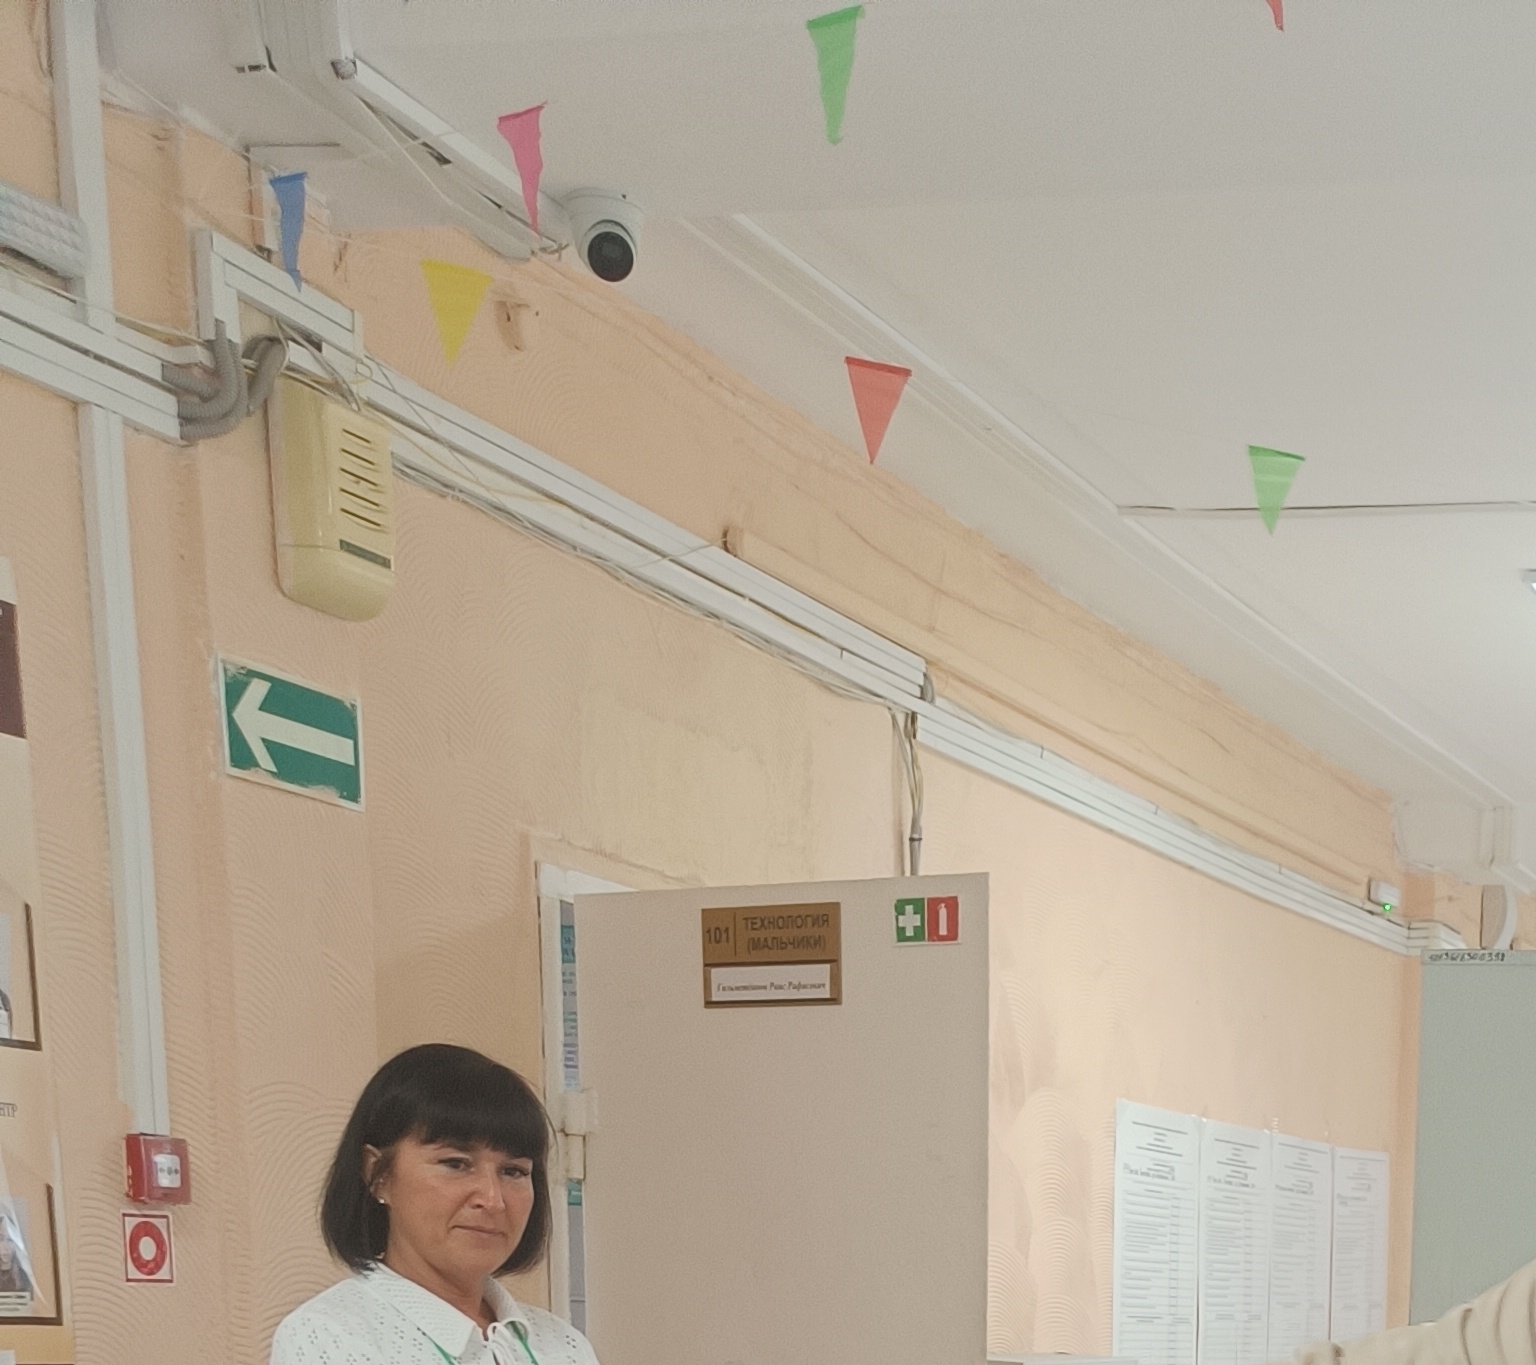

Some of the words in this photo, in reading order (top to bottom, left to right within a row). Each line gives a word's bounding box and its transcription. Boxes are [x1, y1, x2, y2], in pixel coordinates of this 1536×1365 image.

[705, 926, 730, 945] 101
[742, 913, 830, 932] ТЕХНОЛОГИЯ
[746, 934, 827, 955] (МАЛЬЧИКИ)
